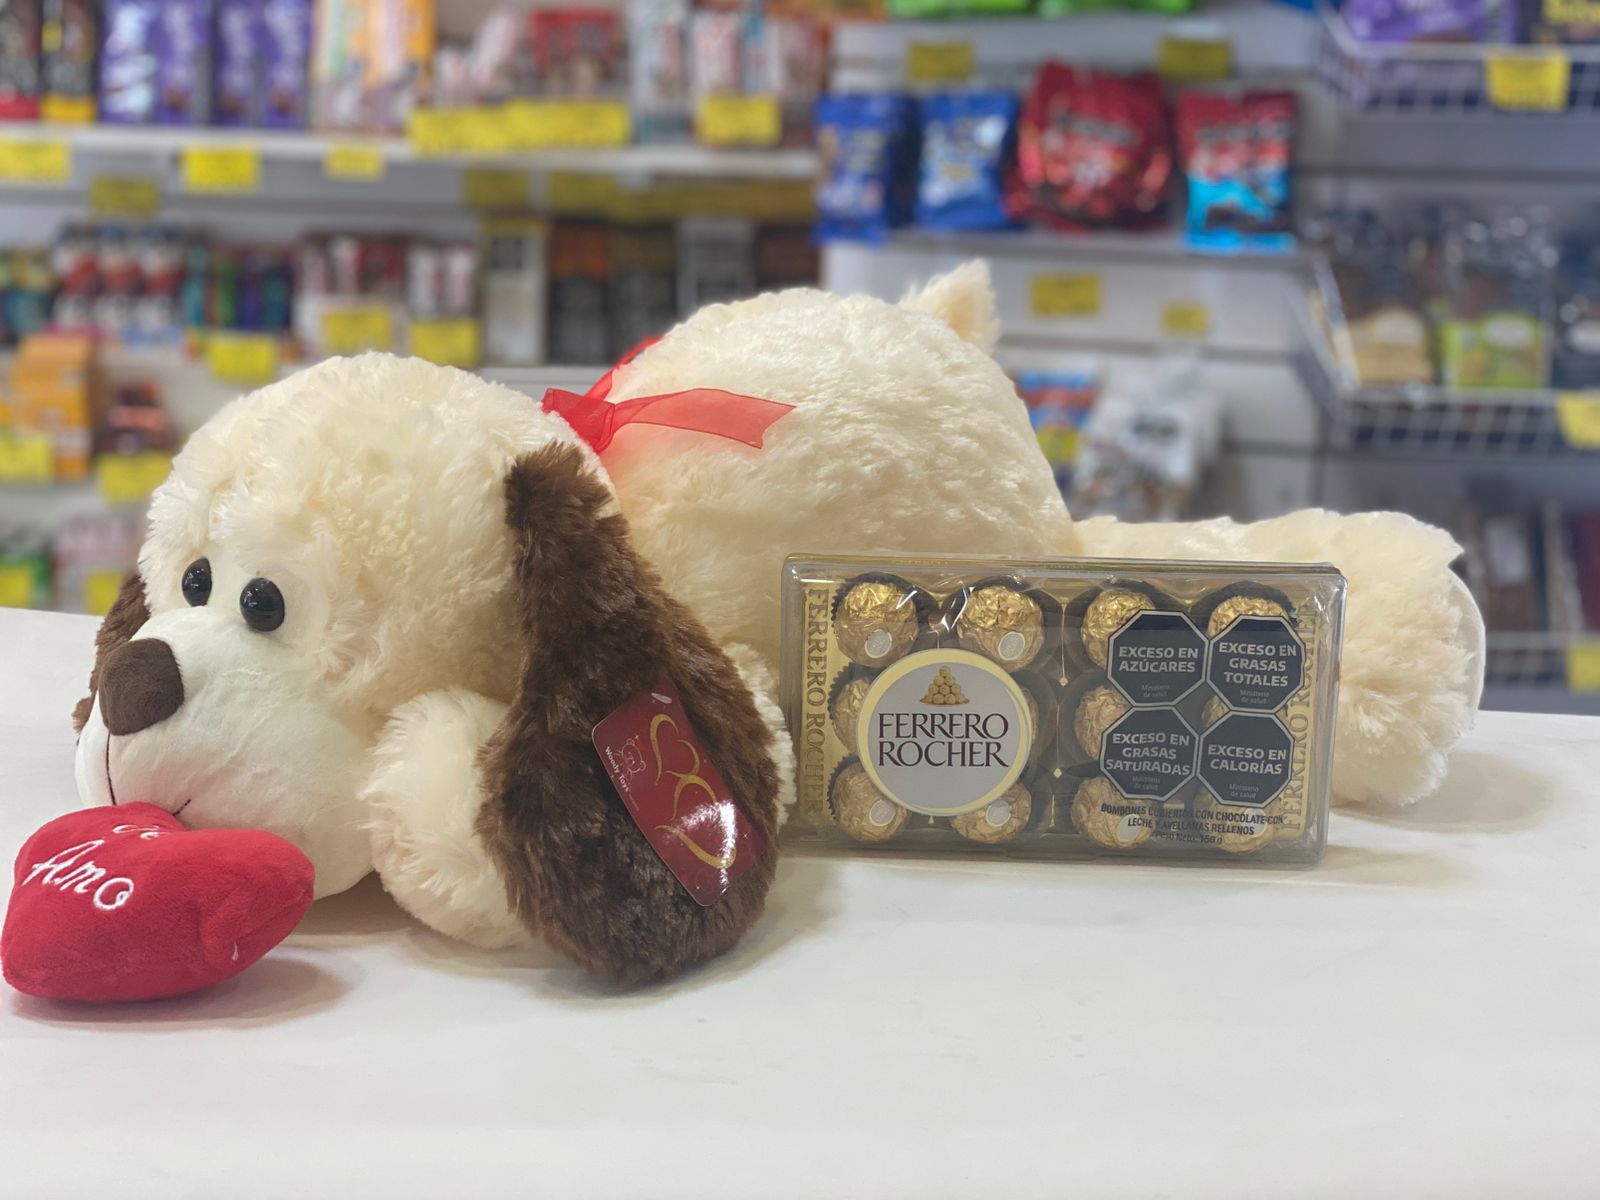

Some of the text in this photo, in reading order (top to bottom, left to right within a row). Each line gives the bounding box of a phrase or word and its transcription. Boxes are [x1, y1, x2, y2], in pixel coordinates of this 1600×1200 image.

[804, 588, 829, 706] FERRERO
[1118, 646, 1199, 659] EXCESO EN
[1219, 642, 1297, 657] EXCESO EN
[1118, 659, 1196, 673] AZÚCARES
[1229, 657, 1287, 672] GRASAS
[1223, 671, 1289, 687] TOTALES
[878, 713, 1009, 739] FERRERO
[1112, 732, 1190, 746] EXCESO EN
[878, 741, 1009, 767] ROCHER
[1122, 746, 1177, 760] GRASAS
[1207, 744, 1287, 761] EXCESO EN
[605, 746, 630, 793] Woody Toys
[1105, 759, 1191, 776] SATURADAS
[1210, 758, 1283, 775] CALORÍAS
[1101, 803, 1147, 816] BOMBONES
[1195, 809, 1214, 820] CON
[1215, 811, 1265, 825] CHOCOLATE
[1267, 815, 1284, 825] CON
[1127, 817, 1153, 829] LECHE
[1211, 823, 1255, 836] RELLENOS
[21, 838, 135, 910] Amo
